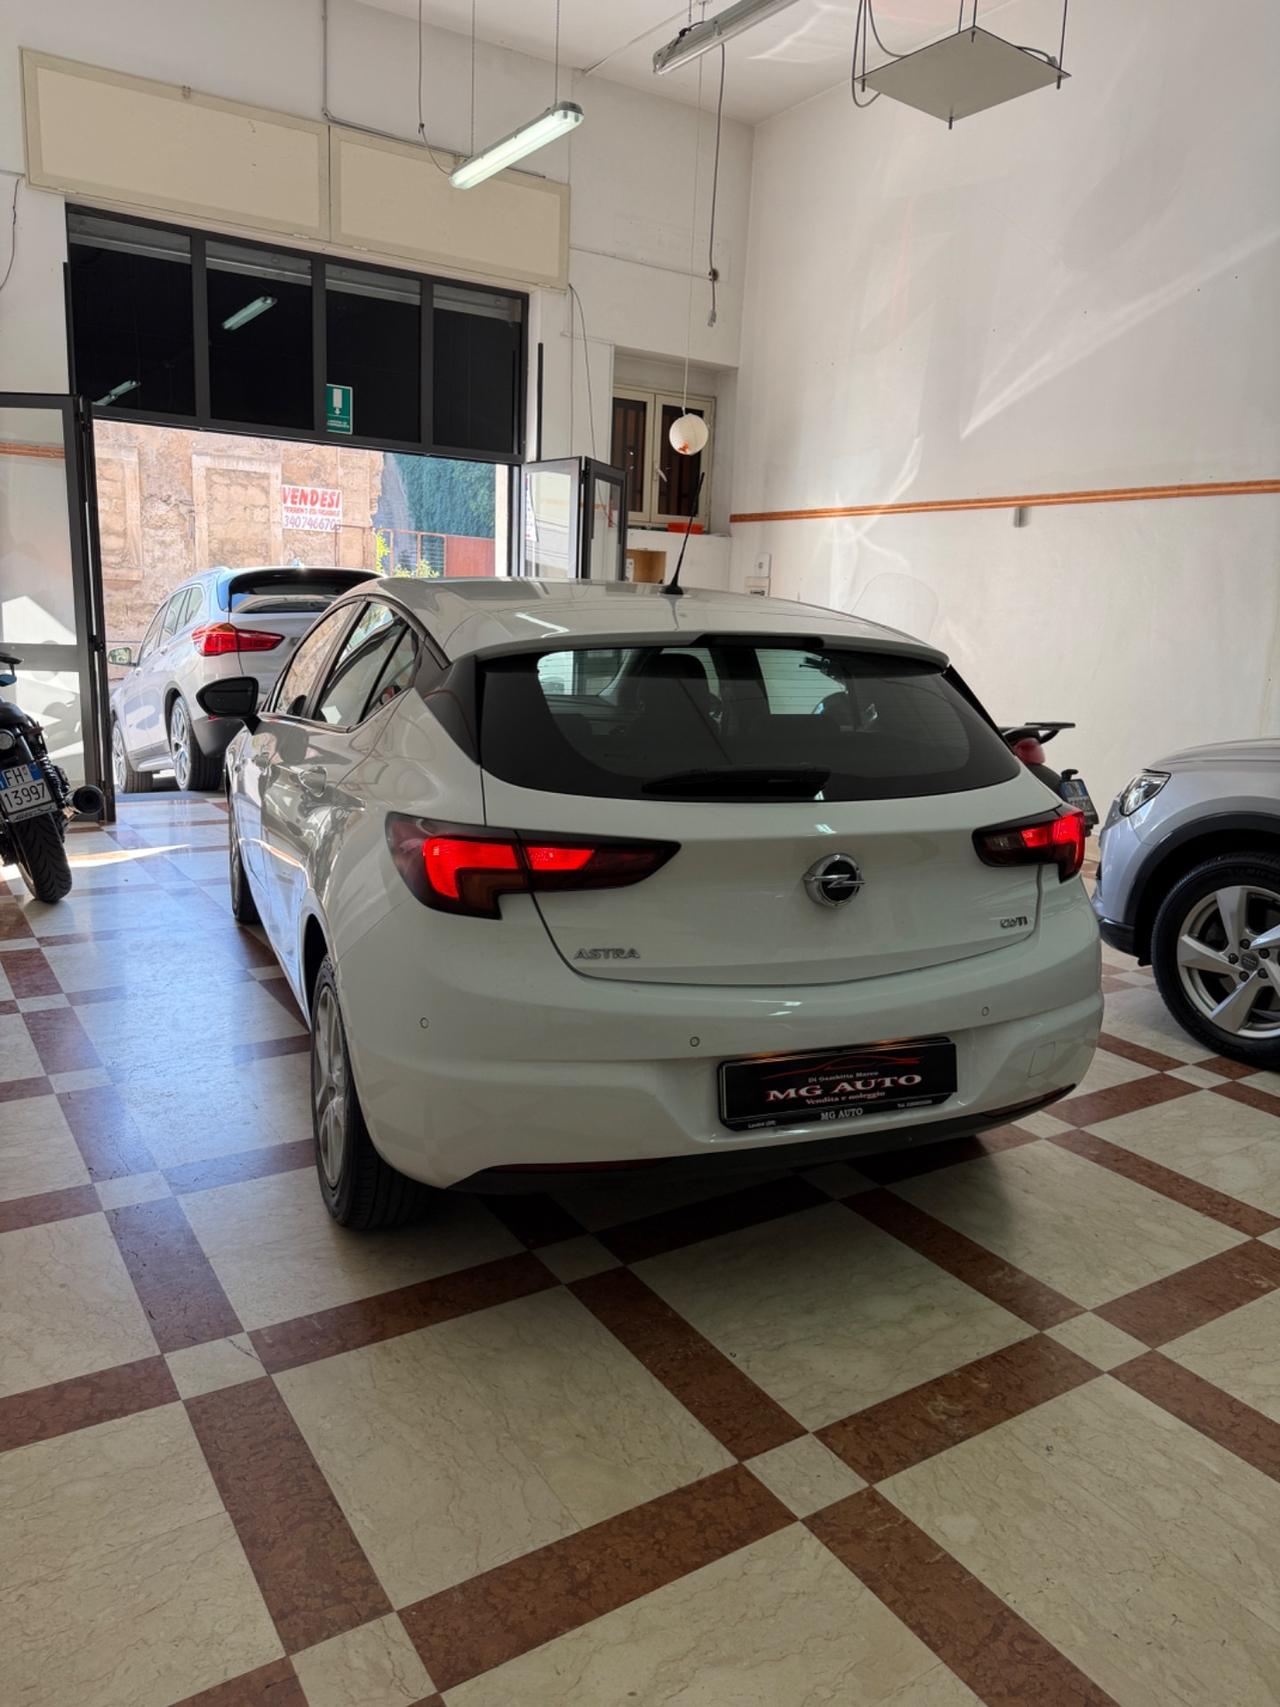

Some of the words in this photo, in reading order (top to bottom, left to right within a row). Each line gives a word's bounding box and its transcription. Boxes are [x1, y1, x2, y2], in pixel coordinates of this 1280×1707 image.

[281, 487, 341, 509] VENDESI
[3, 767, 25, 787] FH
[4, 782, 47, 809] 13997
[573, 947, 641, 961] ASTRA
[766, 1084, 823, 1102] MG
[830, 1074, 923, 1094] AUTO
[820, 1111, 836, 1121] MG
[838, 1107, 864, 1118] AUTO
